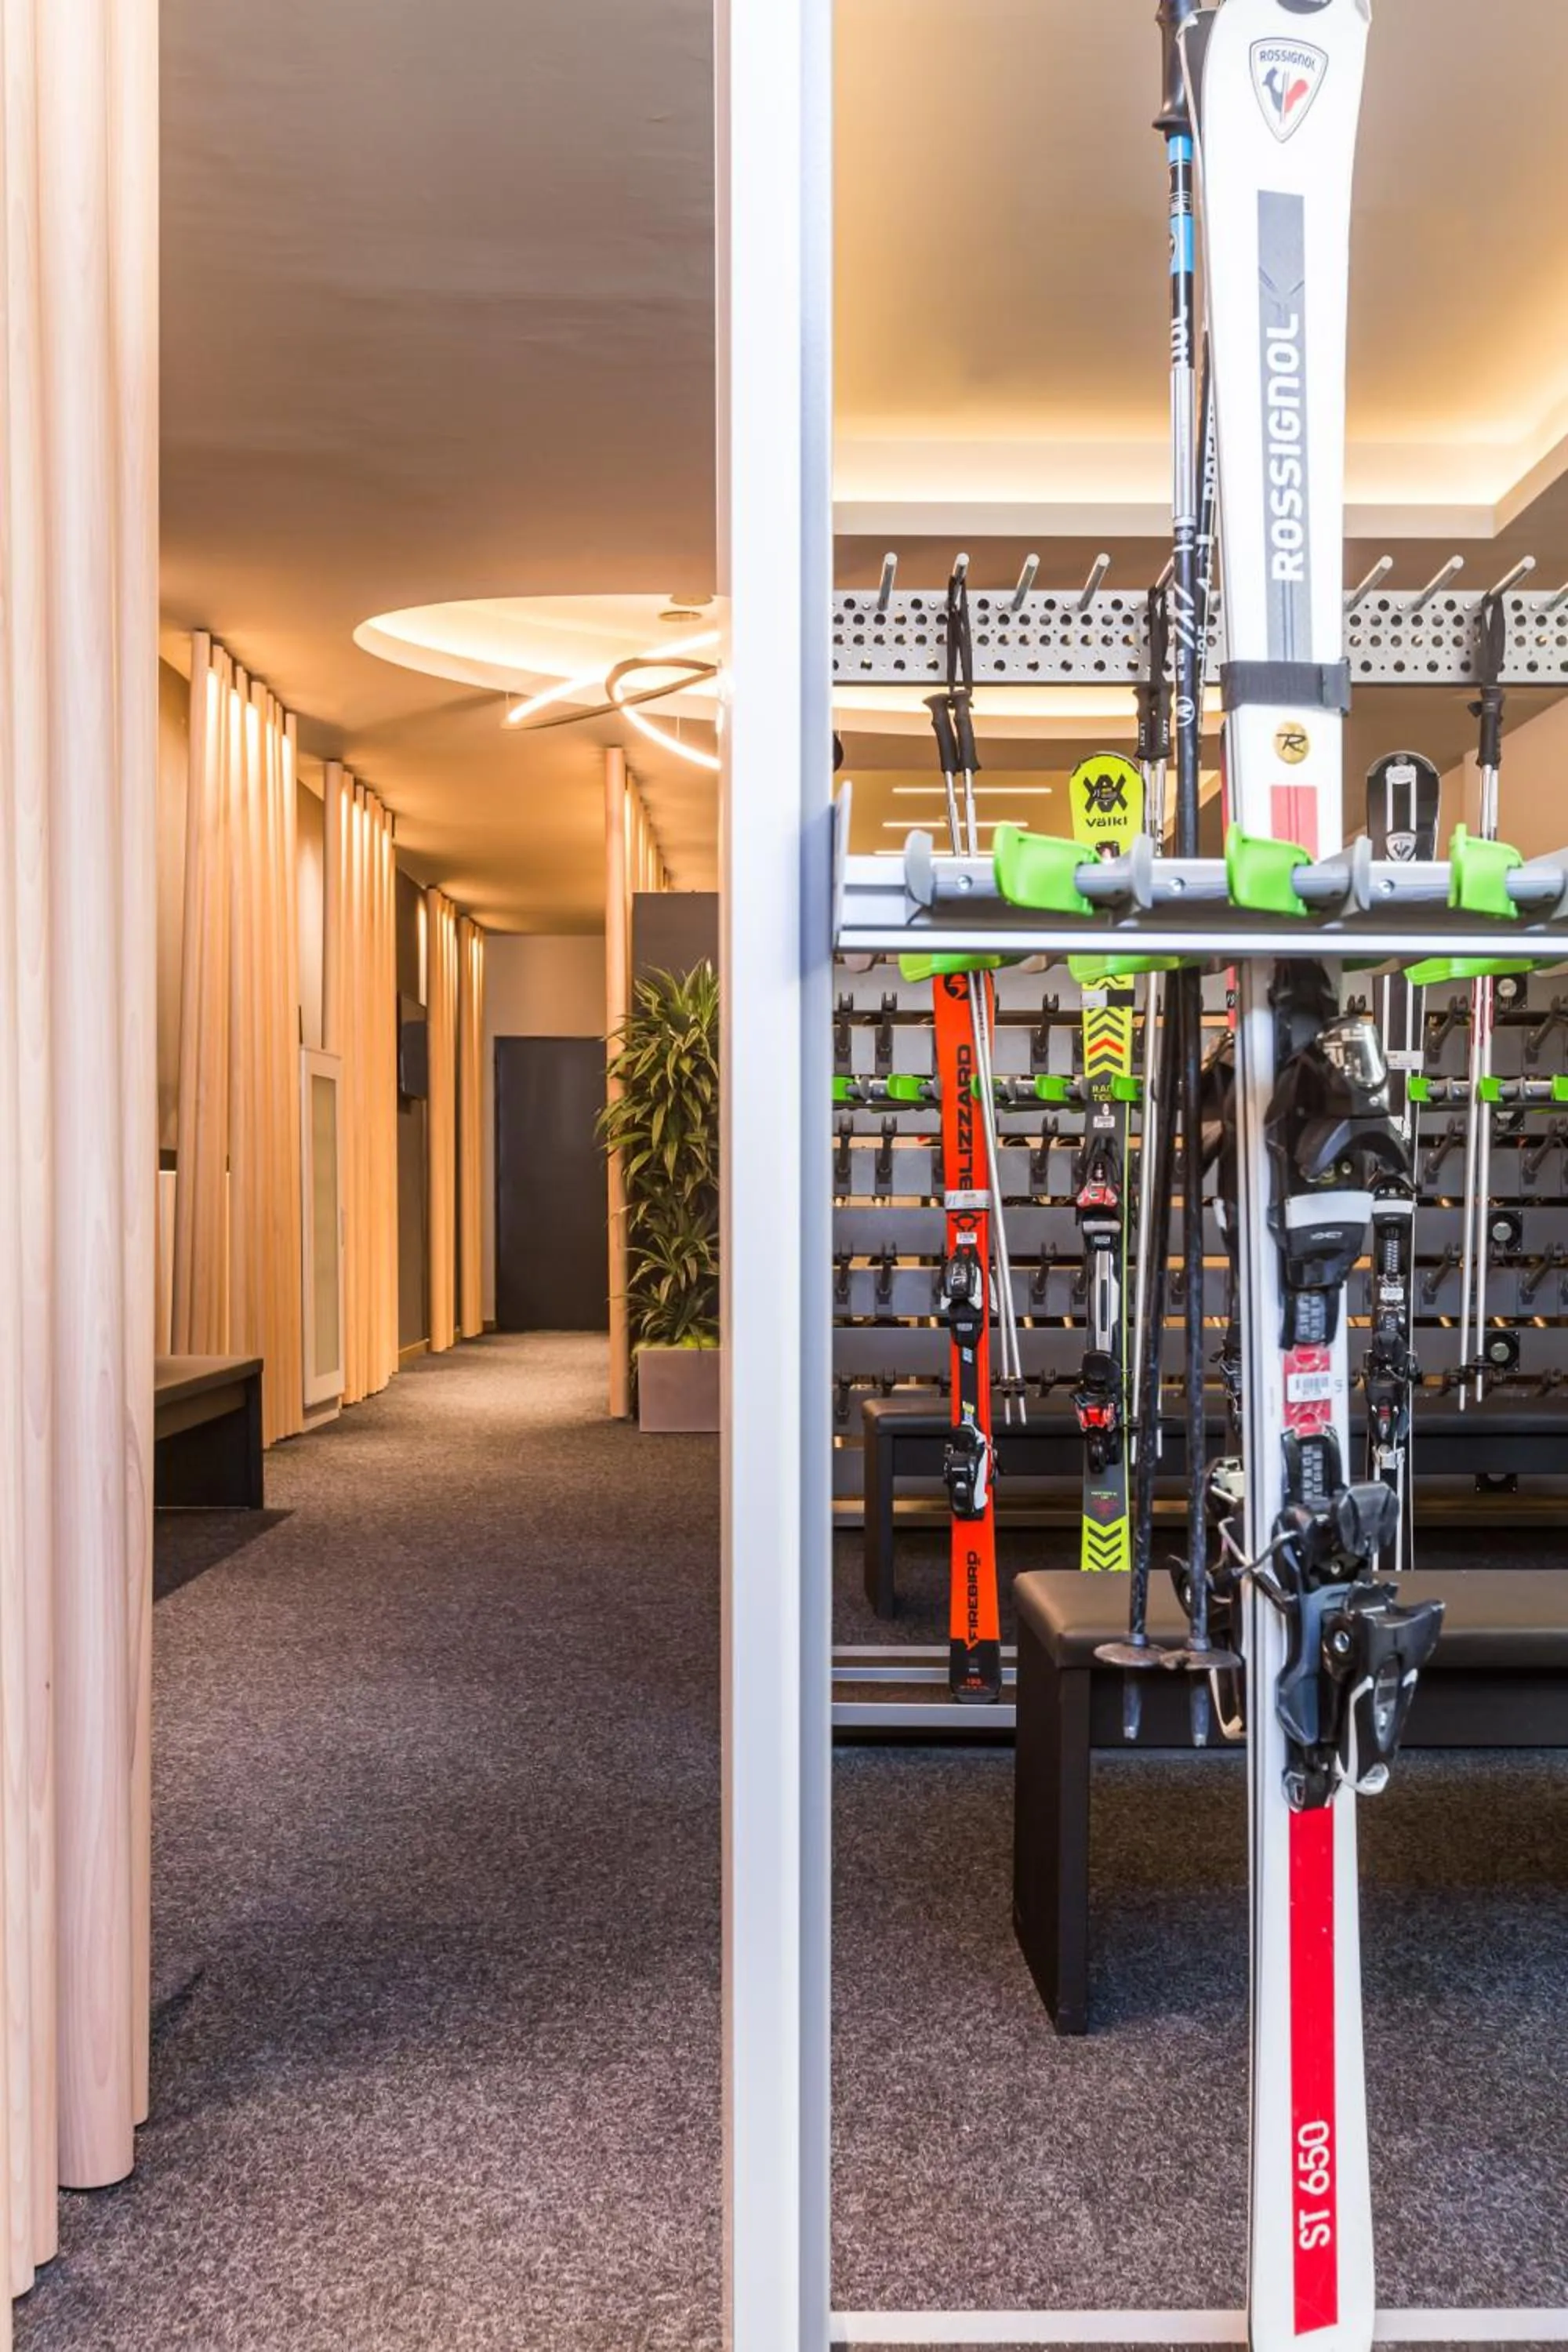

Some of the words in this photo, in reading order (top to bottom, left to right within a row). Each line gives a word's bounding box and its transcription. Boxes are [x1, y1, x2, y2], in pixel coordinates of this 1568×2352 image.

[1259, 49, 1316, 72] ROSSIGNOL
[1266, 313, 1305, 582] ROSSIGNOL
[967, 1551, 978, 1642] FIREBIRD
[1298, 2120, 1330, 2196] 650
[1298, 2209, 1330, 2250] ST
